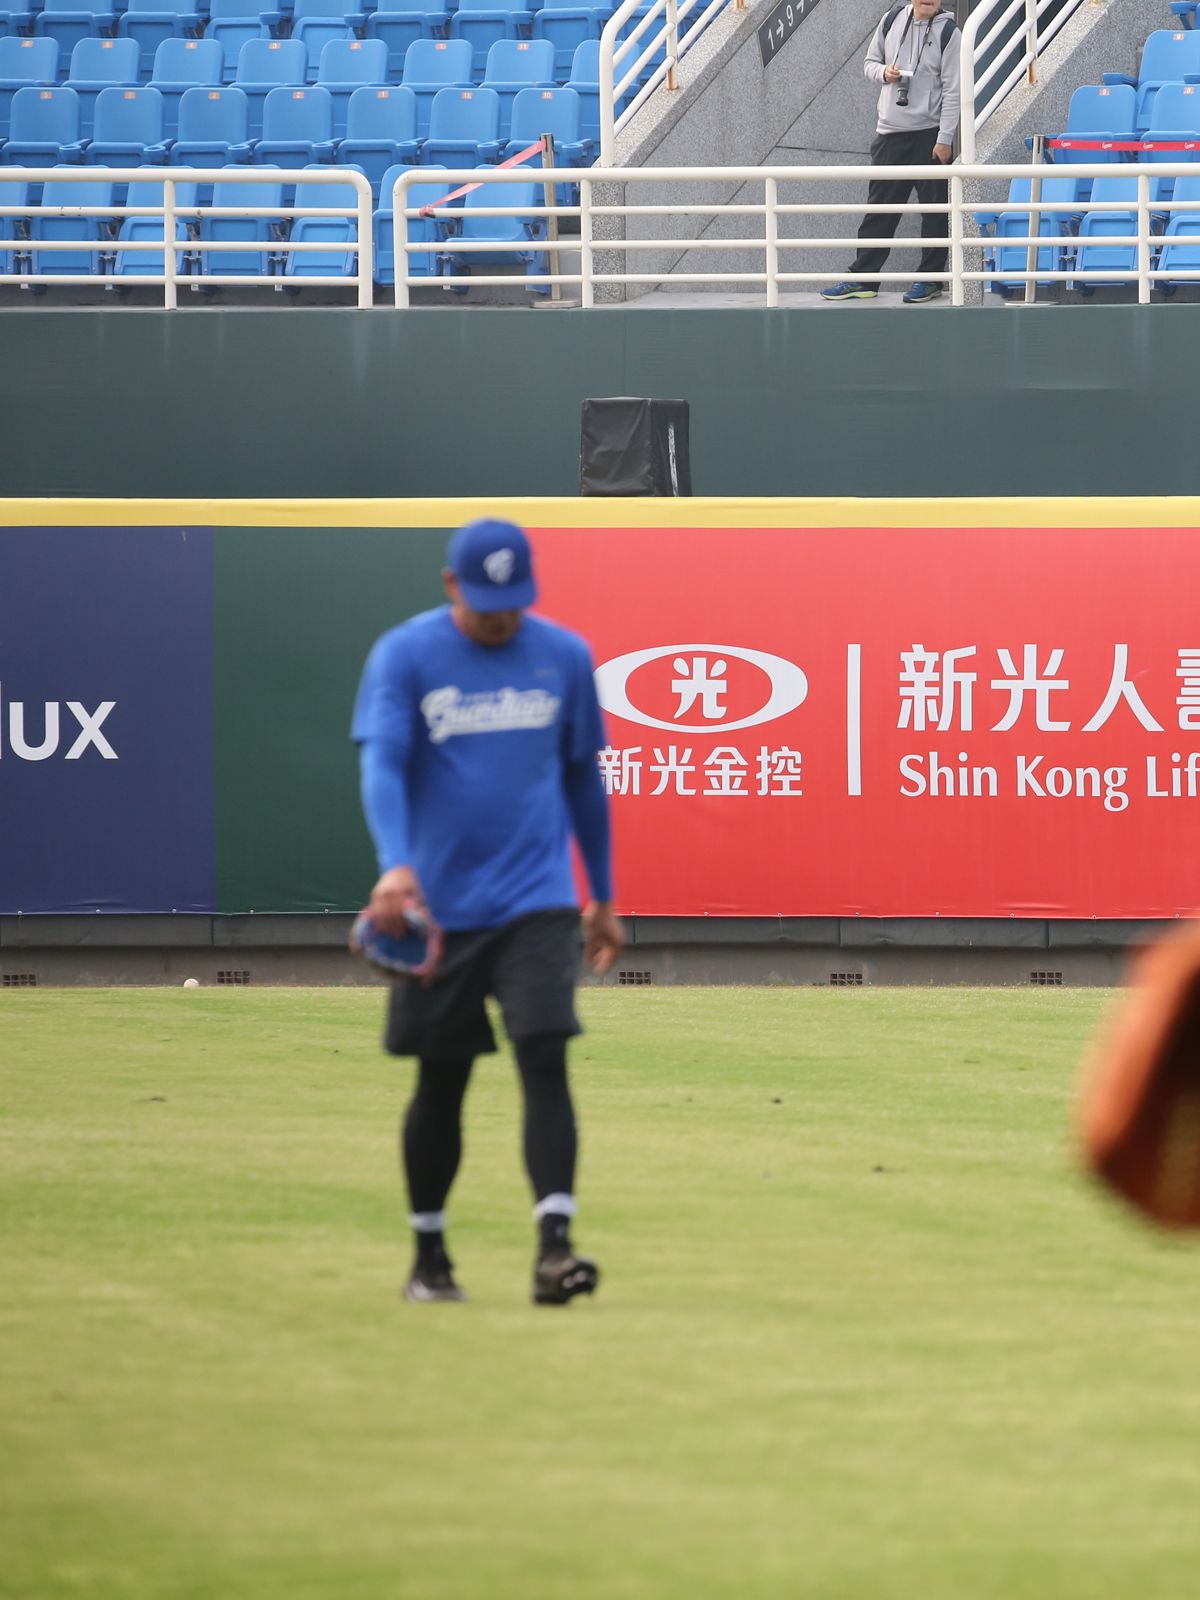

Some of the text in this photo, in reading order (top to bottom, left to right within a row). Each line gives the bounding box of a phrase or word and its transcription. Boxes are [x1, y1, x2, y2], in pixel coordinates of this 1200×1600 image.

[767, 4, 794, 50] 1 9
[0, 682, 119, 761] ux
[597, 745, 803, 796] 新光金控
[899, 751, 998, 798] Shin
[1016, 754, 1130, 812] Kong
